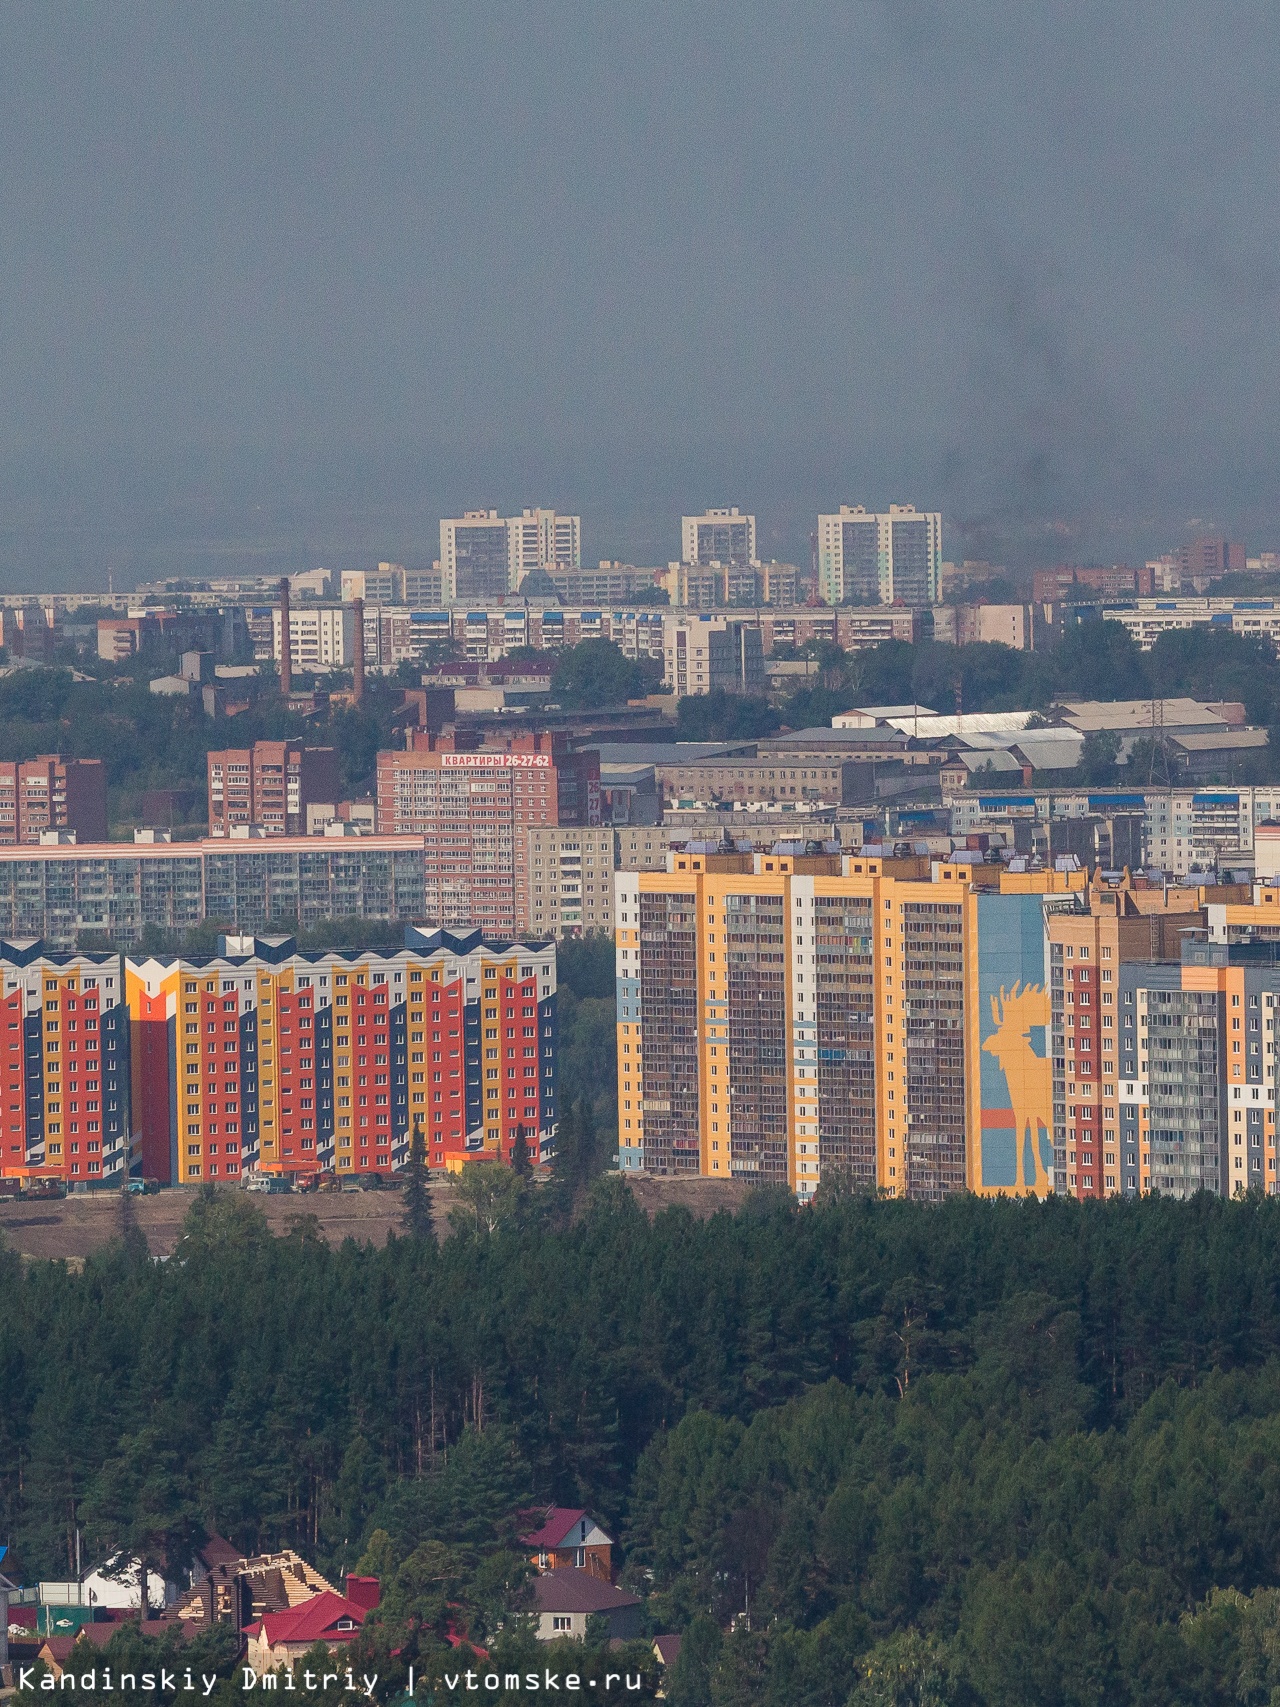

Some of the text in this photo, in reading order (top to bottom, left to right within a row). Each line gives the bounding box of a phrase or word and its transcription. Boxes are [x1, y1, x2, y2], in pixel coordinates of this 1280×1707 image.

[445, 755, 549, 767] КВАРТИРЫ 26-27-62
[589, 798, 599, 810] 27
